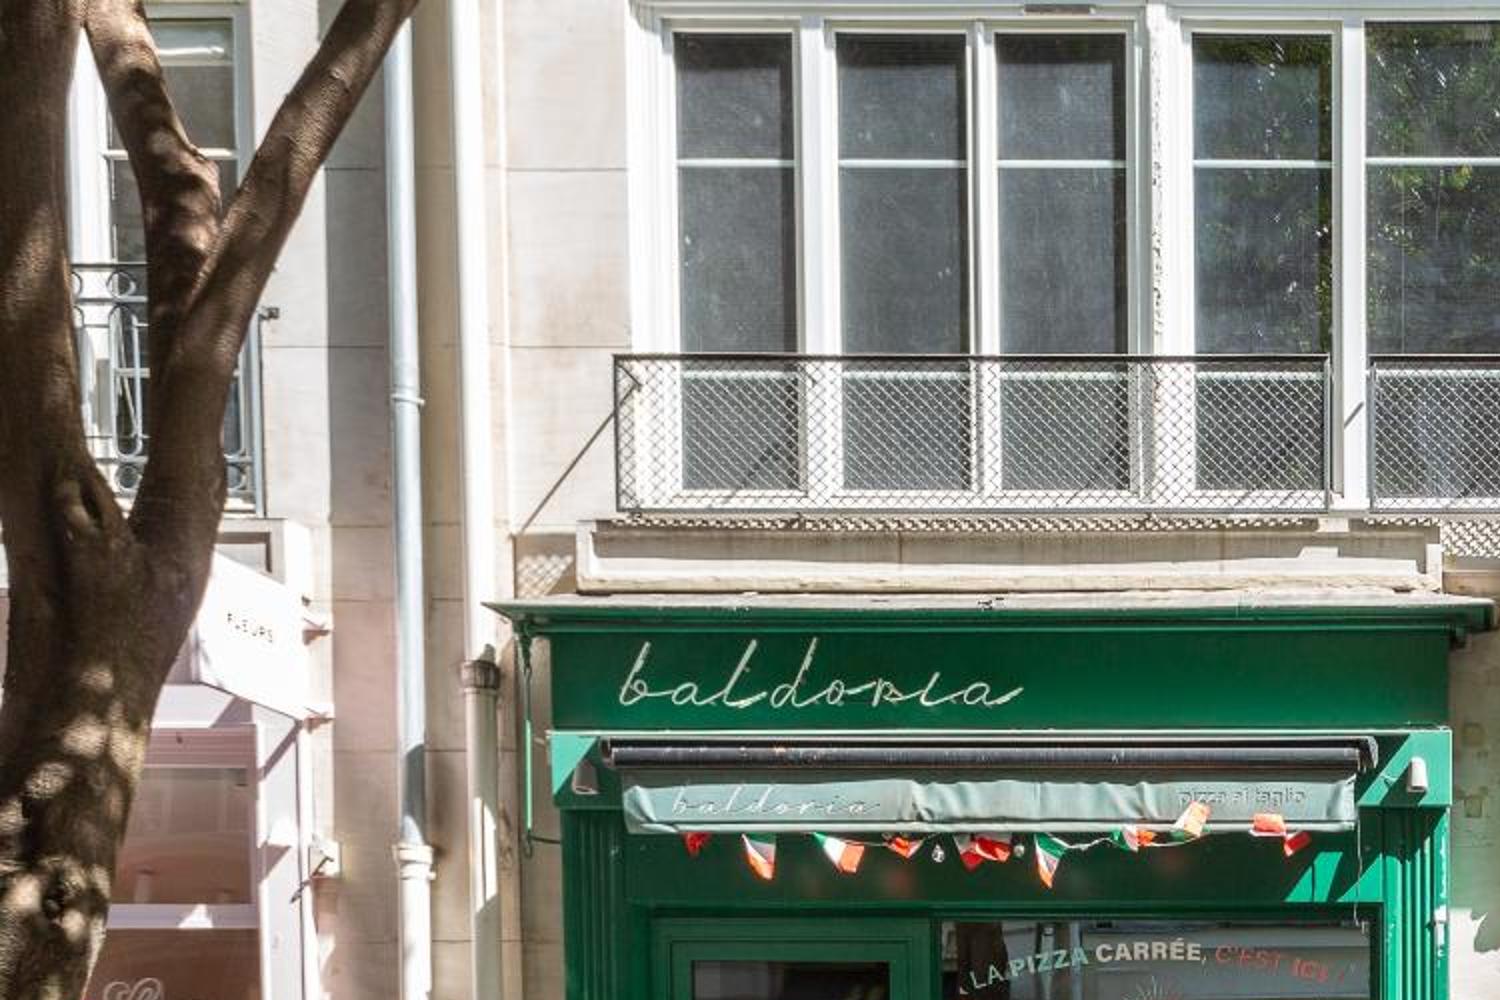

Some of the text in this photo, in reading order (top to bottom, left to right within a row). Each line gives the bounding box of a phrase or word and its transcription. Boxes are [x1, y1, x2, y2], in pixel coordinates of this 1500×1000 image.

[618, 636, 1025, 708] baldoria
[671, 780, 881, 815] baldoria
[969, 966, 1004, 990] LA
[1006, 948, 1088, 977] PIZZA
